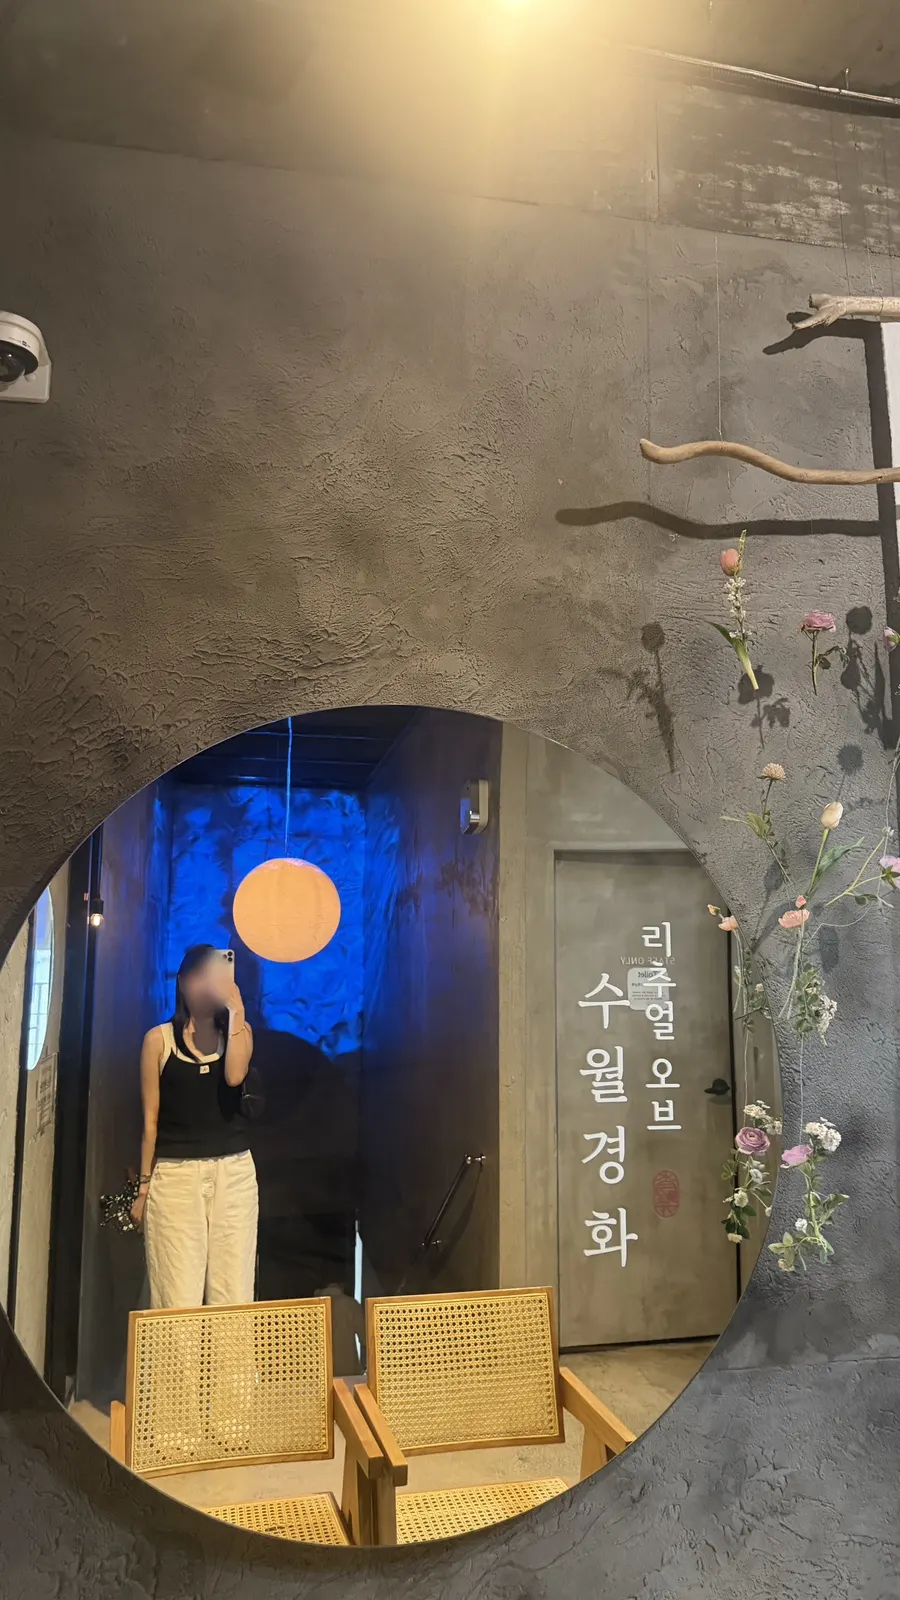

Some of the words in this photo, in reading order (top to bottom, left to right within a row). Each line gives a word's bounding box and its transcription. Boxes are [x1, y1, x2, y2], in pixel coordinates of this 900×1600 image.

[641, 921, 677, 1040] 리추얼
[578, 972, 639, 1268] 수월경화
[645, 1058, 682, 1130] 오브
